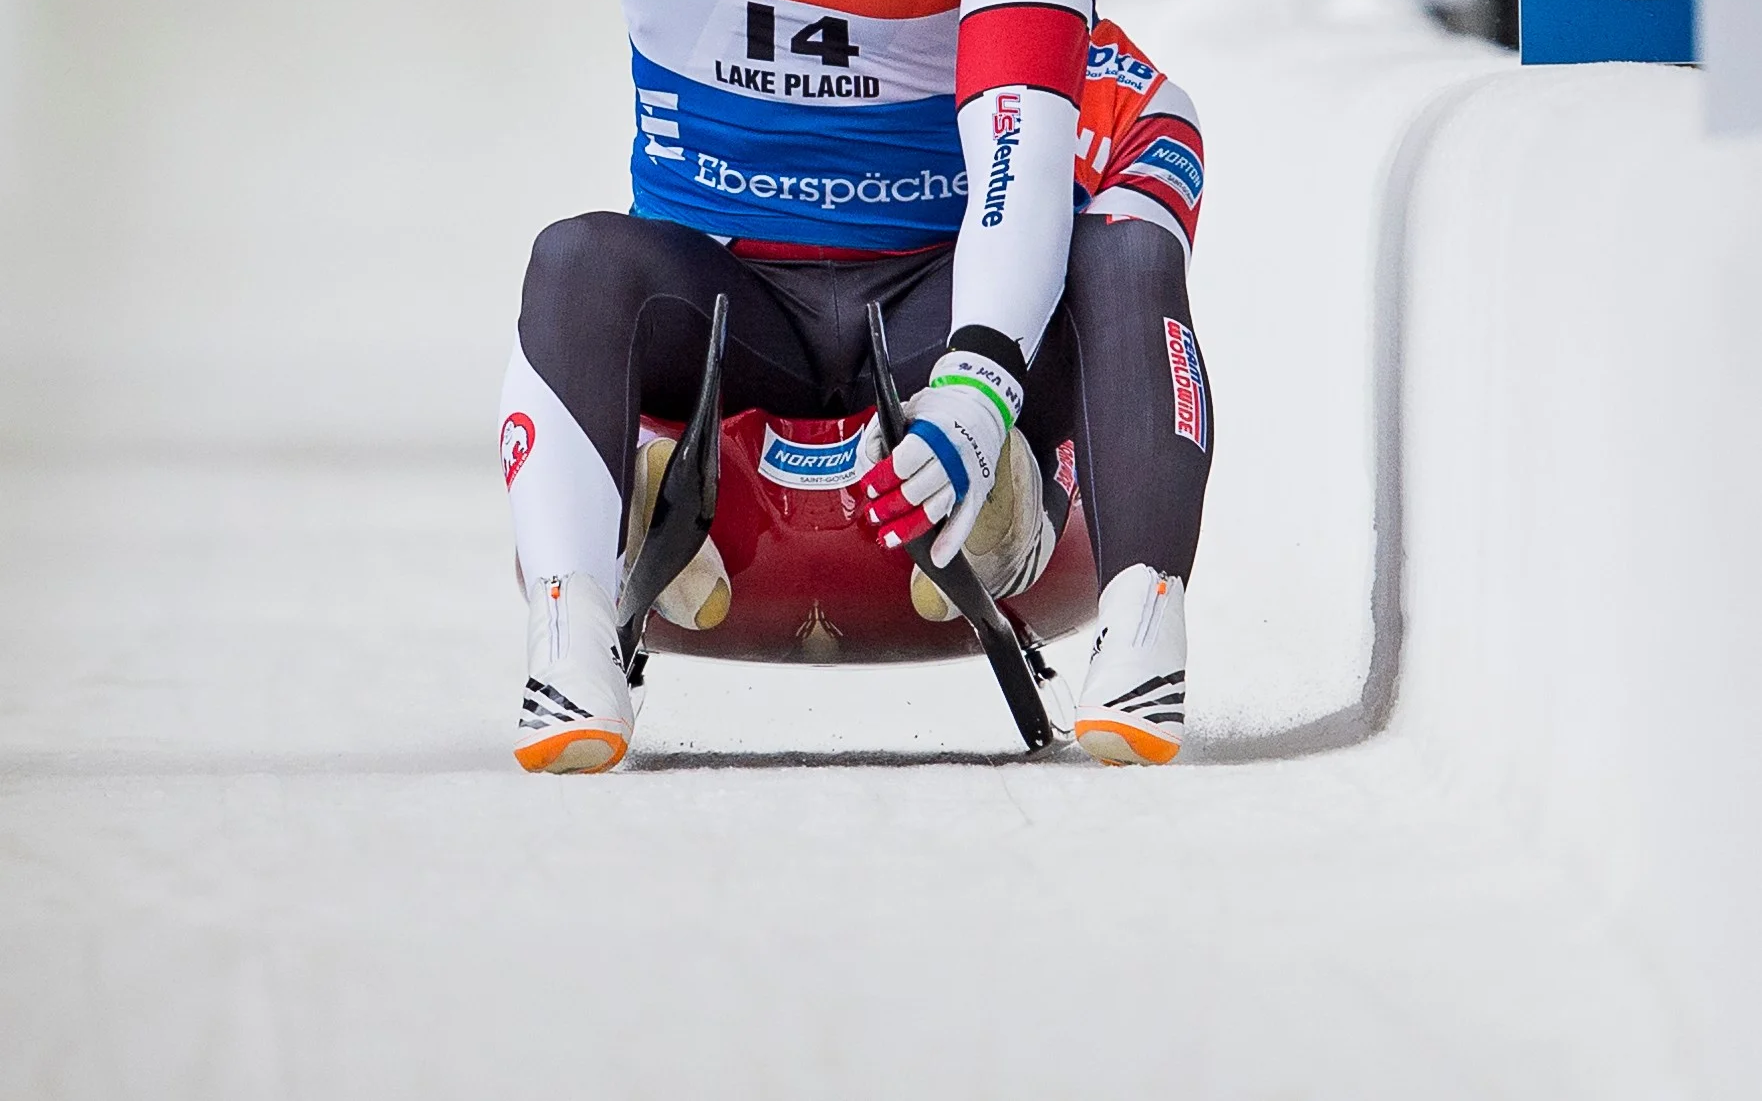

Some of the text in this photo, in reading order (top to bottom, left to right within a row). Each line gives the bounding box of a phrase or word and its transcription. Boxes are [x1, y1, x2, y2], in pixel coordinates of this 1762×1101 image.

[746, 1, 860, 69] 14
[715, 60, 880, 100] LAKE PLACID
[1088, 45, 1155, 80] DKB
[694, 152, 968, 210] Eberspäche
[1152, 147, 1201, 188] NORTON
[1182, 329, 1201, 385] TEAM
[775, 448, 855, 468] NORTON
[954, 421, 991, 479] ORTEMA
